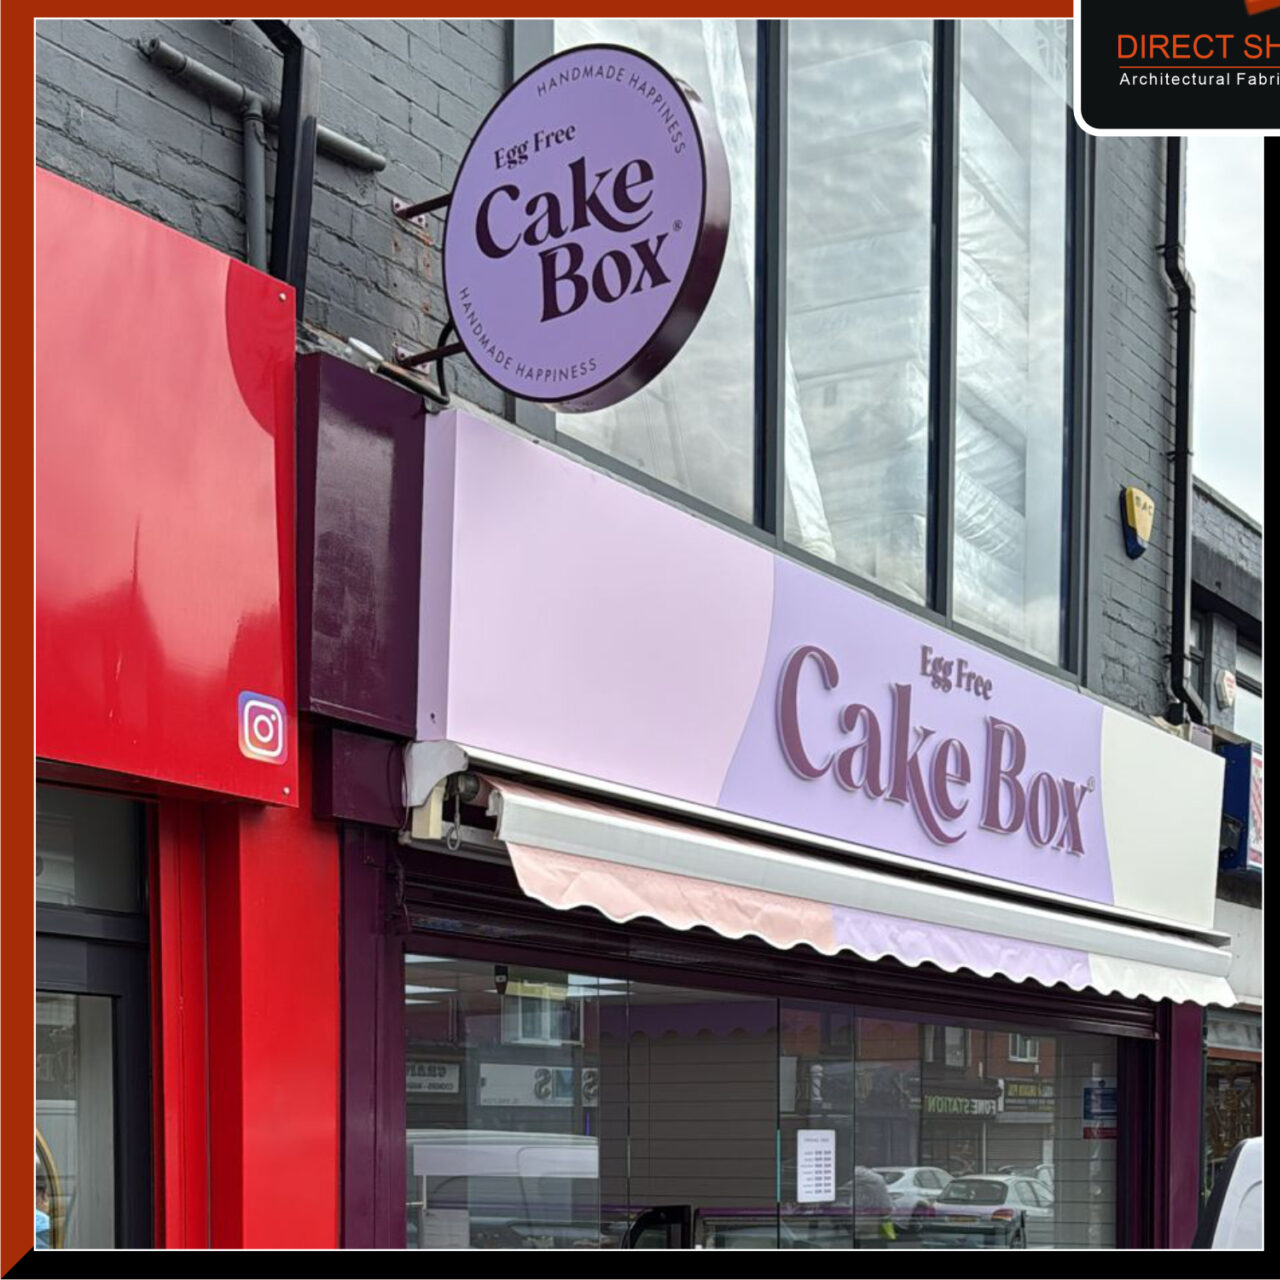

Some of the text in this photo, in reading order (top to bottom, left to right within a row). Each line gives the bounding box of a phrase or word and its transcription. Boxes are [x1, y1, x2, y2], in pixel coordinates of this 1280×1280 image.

[494, 124, 576, 169] Egg Free
[537, 65, 687, 155] HANDMADE HAPPINESS
[475, 156, 655, 259] Cake
[538, 232, 672, 323] Box
[459, 287, 598, 383] HANDMADE HAPPINESS
[919, 644, 993, 701] Egg Free
[775, 645, 971, 846] Cake
[979, 715, 1089, 857] Box
